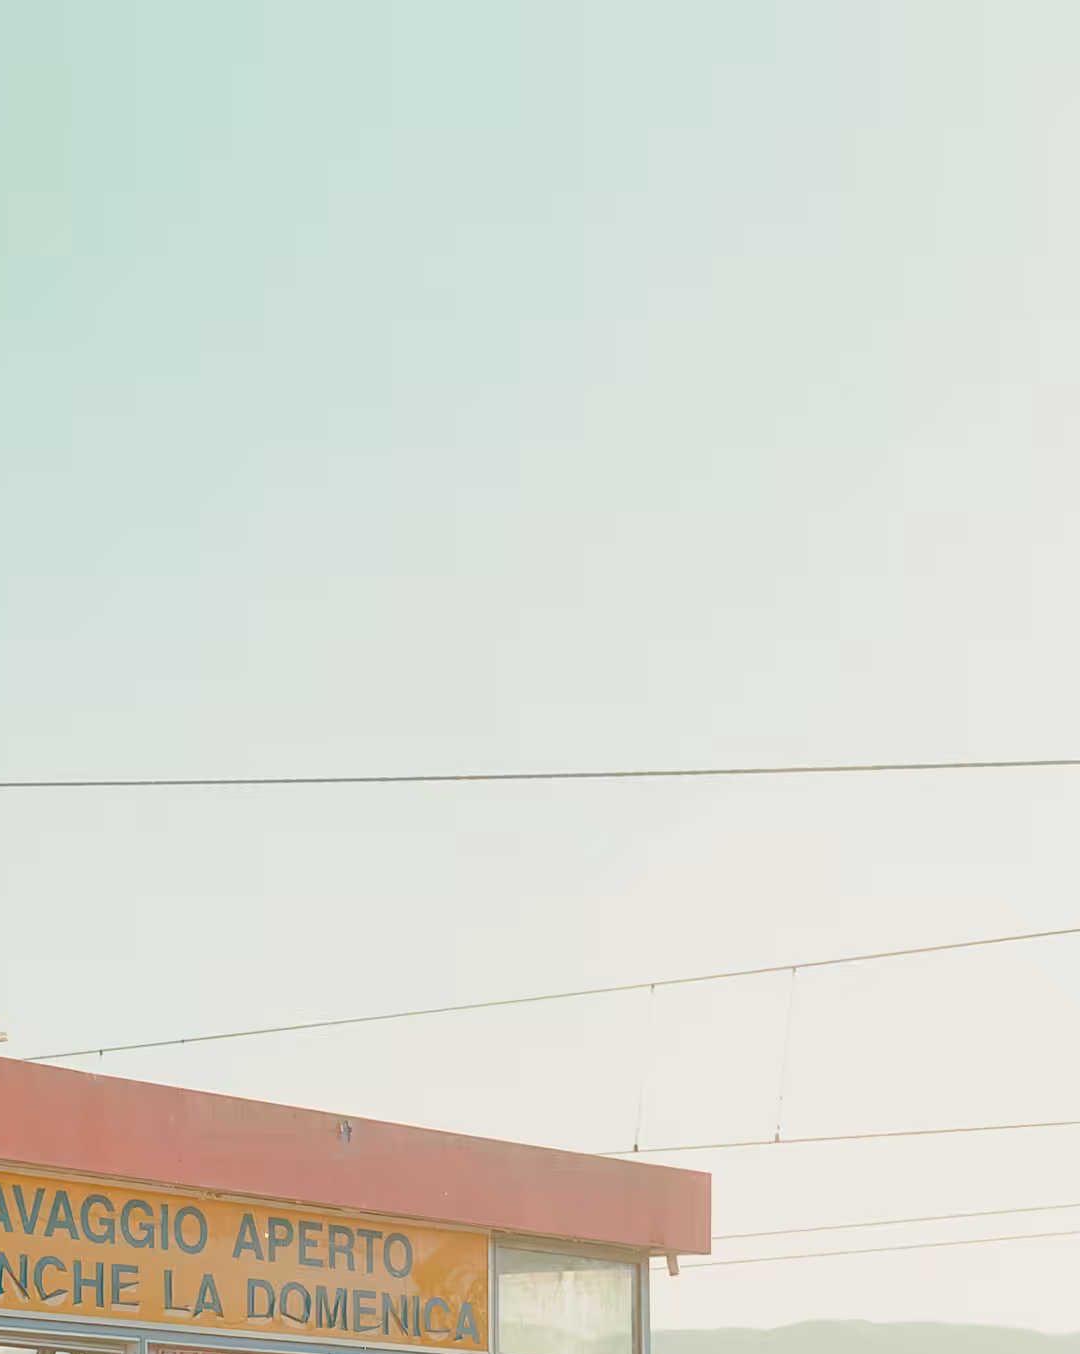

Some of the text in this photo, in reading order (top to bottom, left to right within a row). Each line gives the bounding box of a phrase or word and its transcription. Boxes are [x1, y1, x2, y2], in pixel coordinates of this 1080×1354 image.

[232, 1213, 414, 1279] APERTO
[163, 1270, 224, 1319] LA
[246, 1278, 480, 1345] DOMENICA
